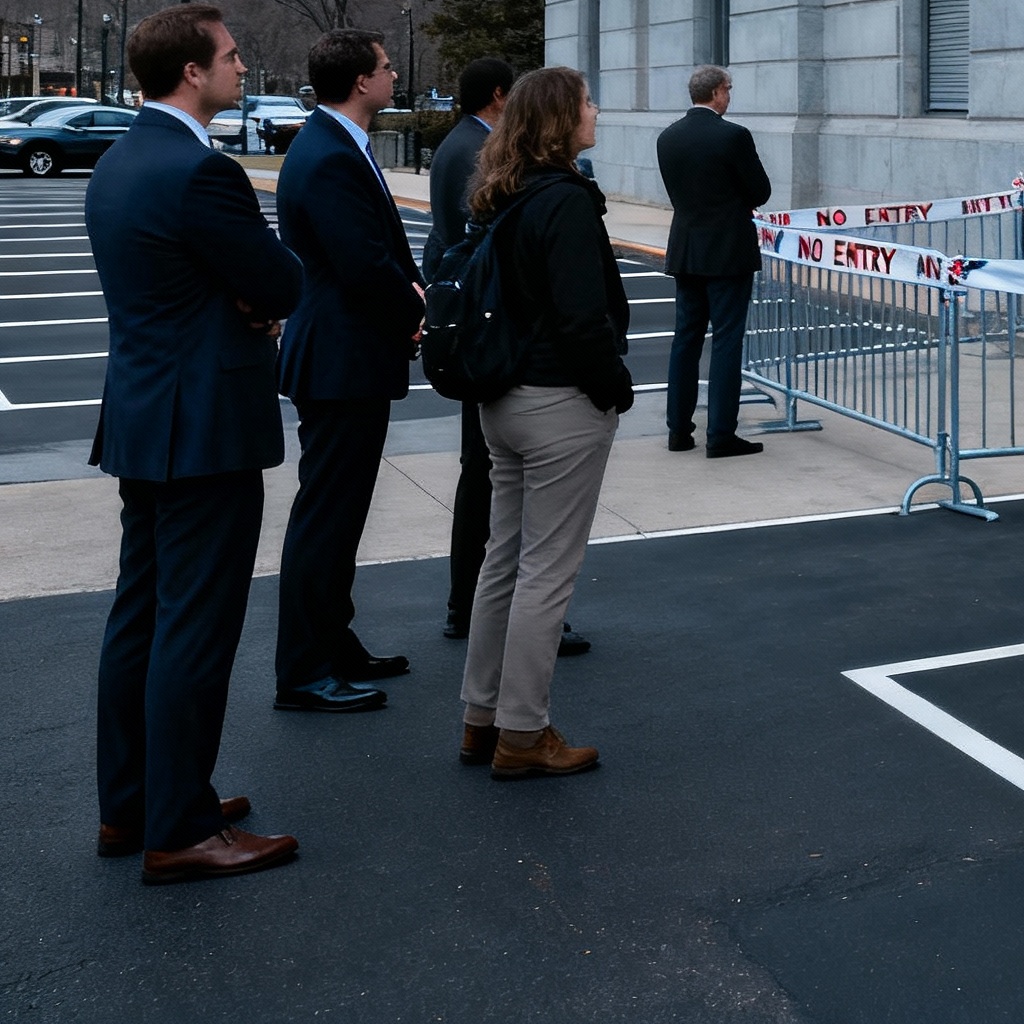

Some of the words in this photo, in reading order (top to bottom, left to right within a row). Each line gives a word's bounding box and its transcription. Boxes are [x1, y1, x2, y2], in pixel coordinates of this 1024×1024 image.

[817, 209, 847, 226] NO
[798, 235, 823, 262] NO
[834, 240, 897, 274] ENTRY
